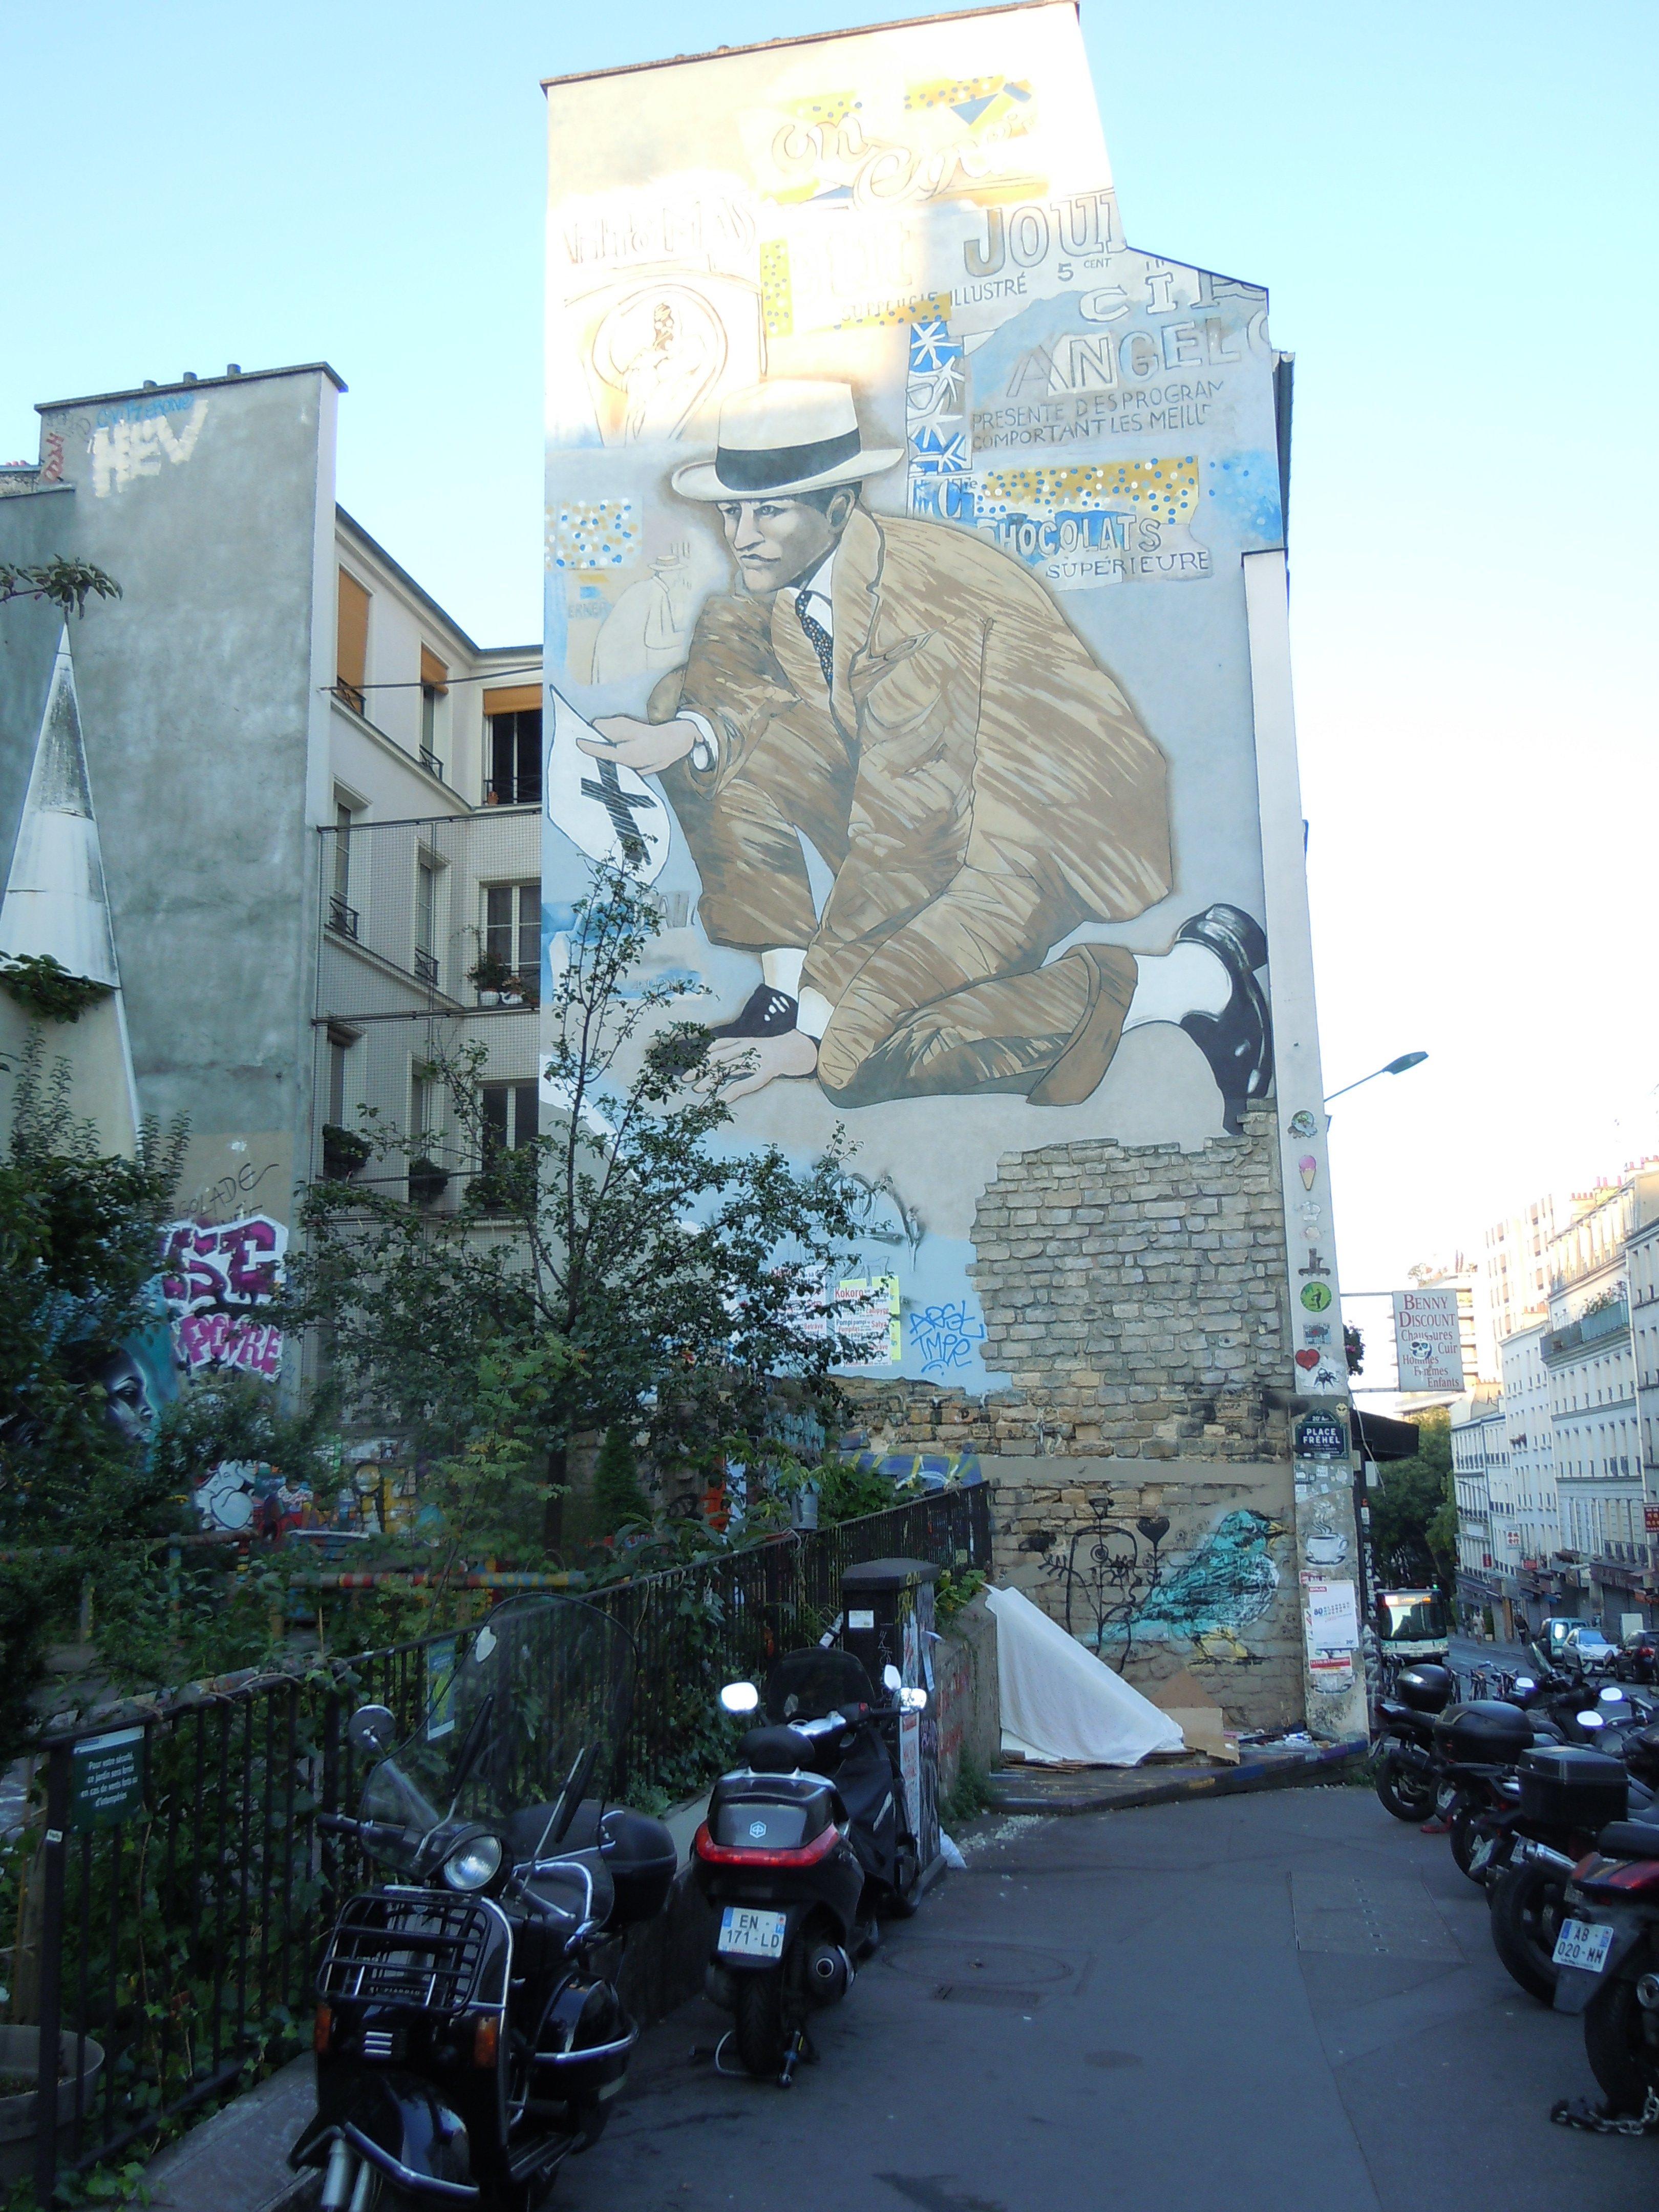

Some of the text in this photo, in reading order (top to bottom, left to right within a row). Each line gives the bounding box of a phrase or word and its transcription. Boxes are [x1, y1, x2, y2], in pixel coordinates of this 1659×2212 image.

[1057, 257, 1112, 282] 5 CENT
[949, 275, 1027, 307] ILLUSTRÉ
[972, 417, 1107, 450] COMPORTANT
[1110, 413, 1143, 435] LES
[835, 1287, 863, 1298] Kokoro
[1438, 1342, 1458, 1354] Cuir
[1428, 1377, 1459, 1388] Enfants
[1306, 1428, 1336, 1436] PLACE
[1303, 1435, 1341, 1444] FRÉHEL
